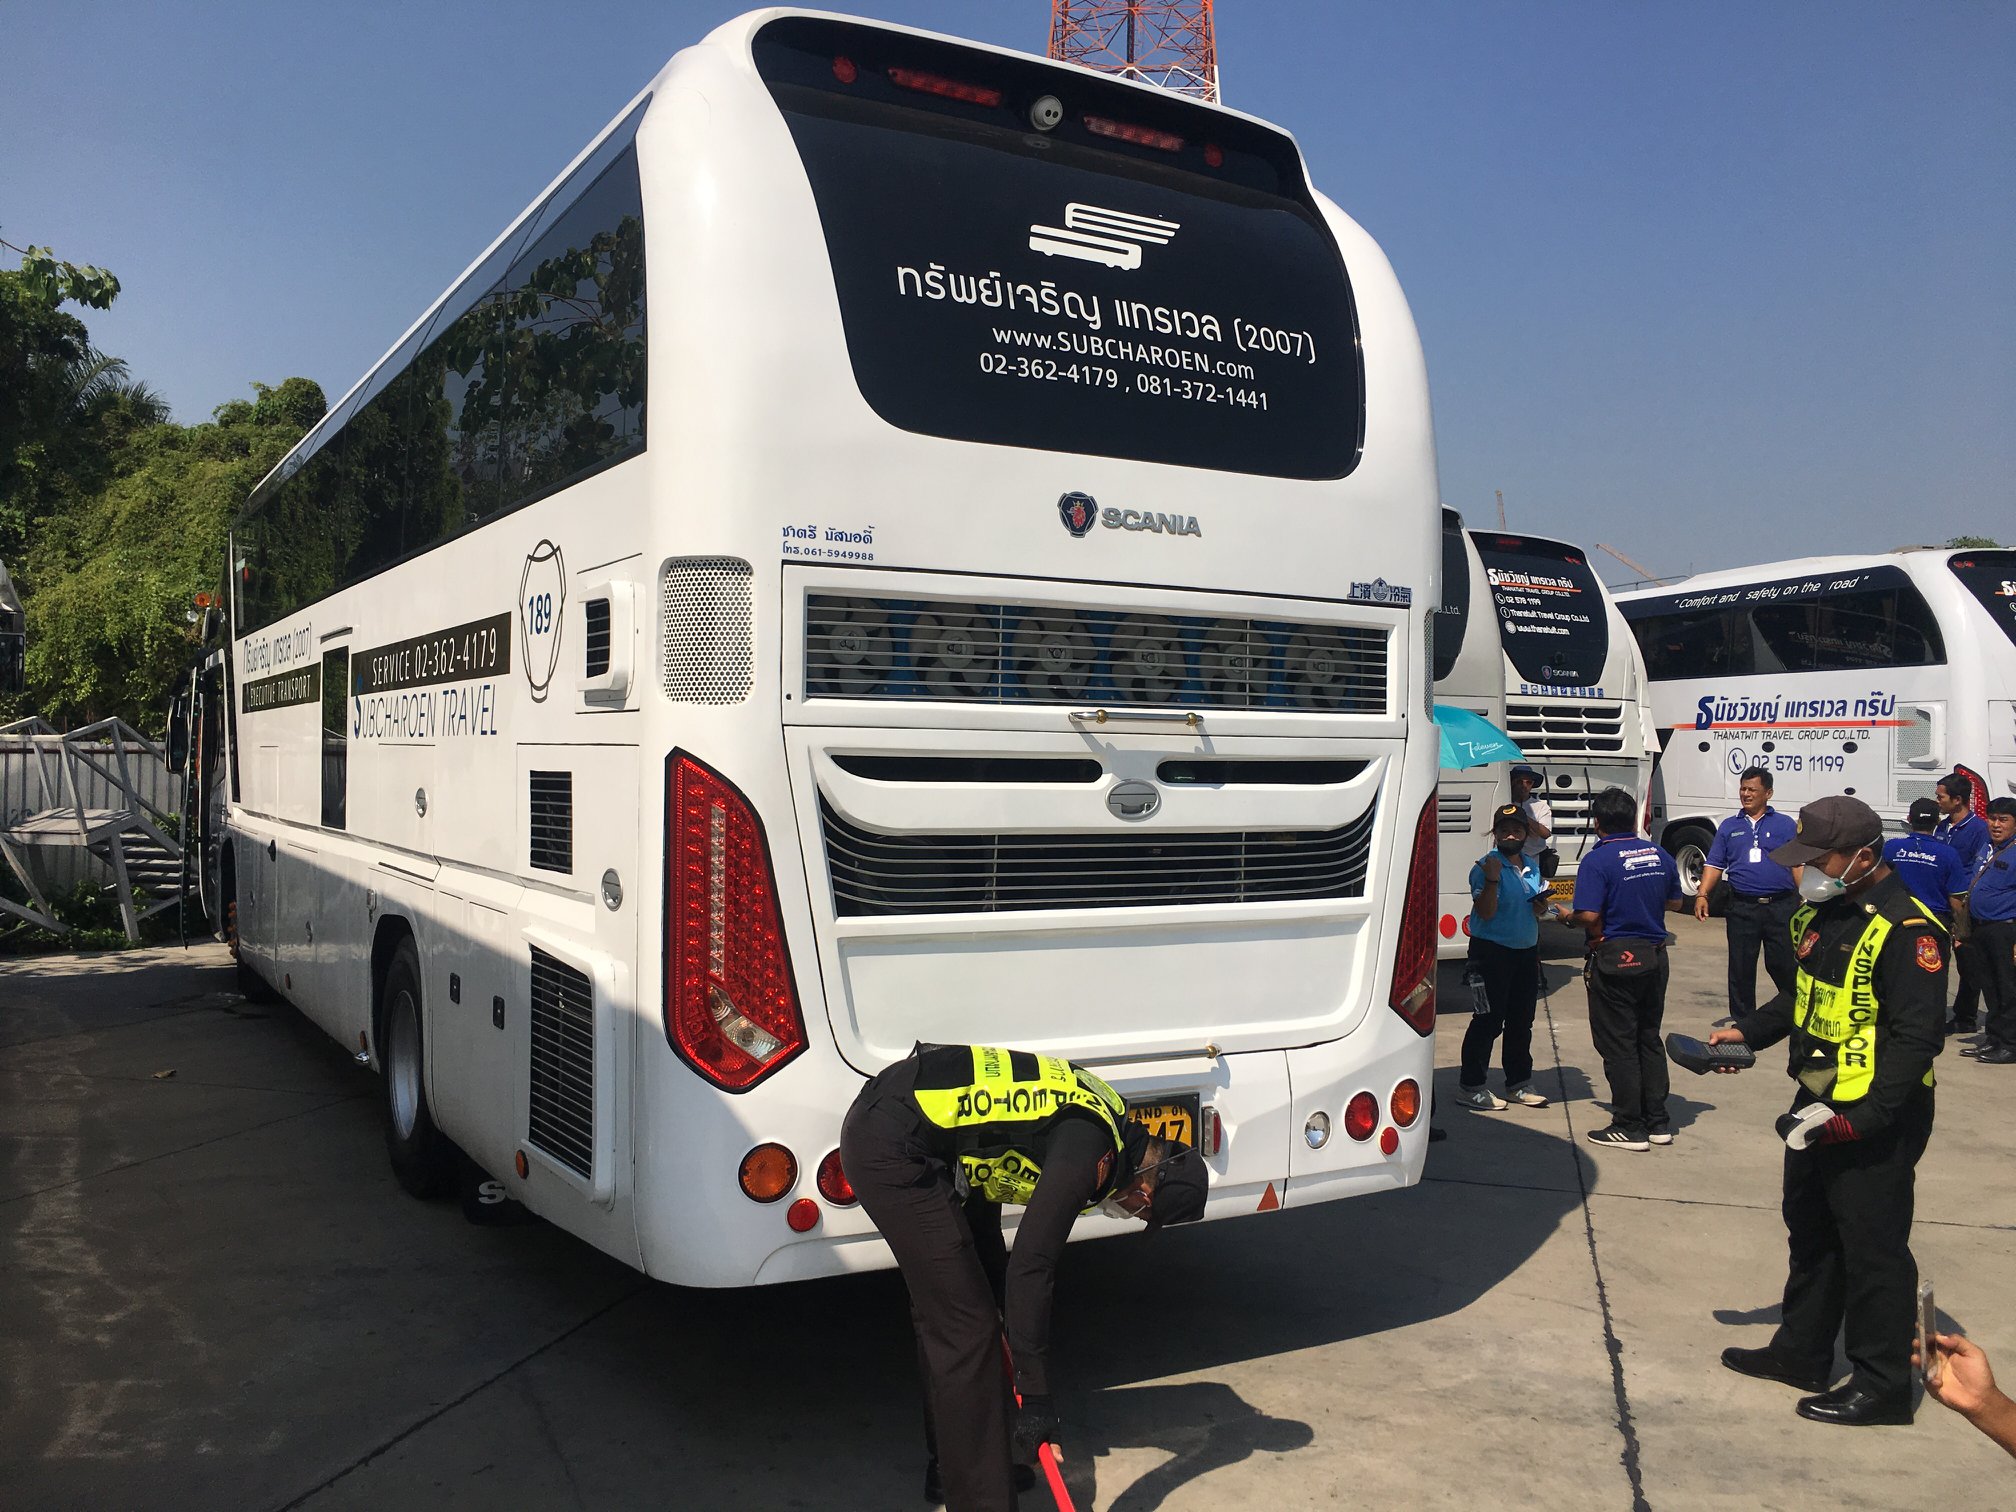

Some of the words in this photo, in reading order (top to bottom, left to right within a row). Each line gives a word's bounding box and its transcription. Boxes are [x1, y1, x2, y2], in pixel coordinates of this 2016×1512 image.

[897, 262, 1101, 330] ทรัพย์เจริญ
[1114, 299, 1222, 343] แทรเวล
[1233, 318, 1317, 364] (2007)
[992, 326, 1255, 381] www.SUBCHAROEN.com
[979, 353, 1118, 389] 02-362-4179
[1136, 373, 1269, 411] 081-372-1441
[1101, 507, 1202, 538] SCANIA
[1718, 591, 1741, 604] and
[1745, 587, 1780, 601] safety
[1782, 584, 1799, 595] on
[1801, 581, 1822, 594] the
[528, 593, 551, 635] 189
[372, 649, 410, 686] SERVICE
[414, 627, 497, 677] 02-362-4179
[1552, 669, 1579, 678] SCANIA
[278, 674, 311, 702] TRANSPORT
[354, 676, 437, 739] SUBCHAROEN
[442, 684, 497, 737] TRAVEL
[1695, 694, 1782, 730] ธนัชวิชญ์
[1784, 699, 1848, 719] แทรเวล
[1854, 691, 1896, 726] กรุ๊ป
[1713, 730, 1760, 741] THANATWIT
[1761, 730, 1795, 741] TRAVEL
[1798, 729, 1829, 741] GROUP
[1775, 755, 1803, 772] 578
[1809, 755, 1845, 772] 1199
[1845, 928, 1880, 1069] INSPECTOR
